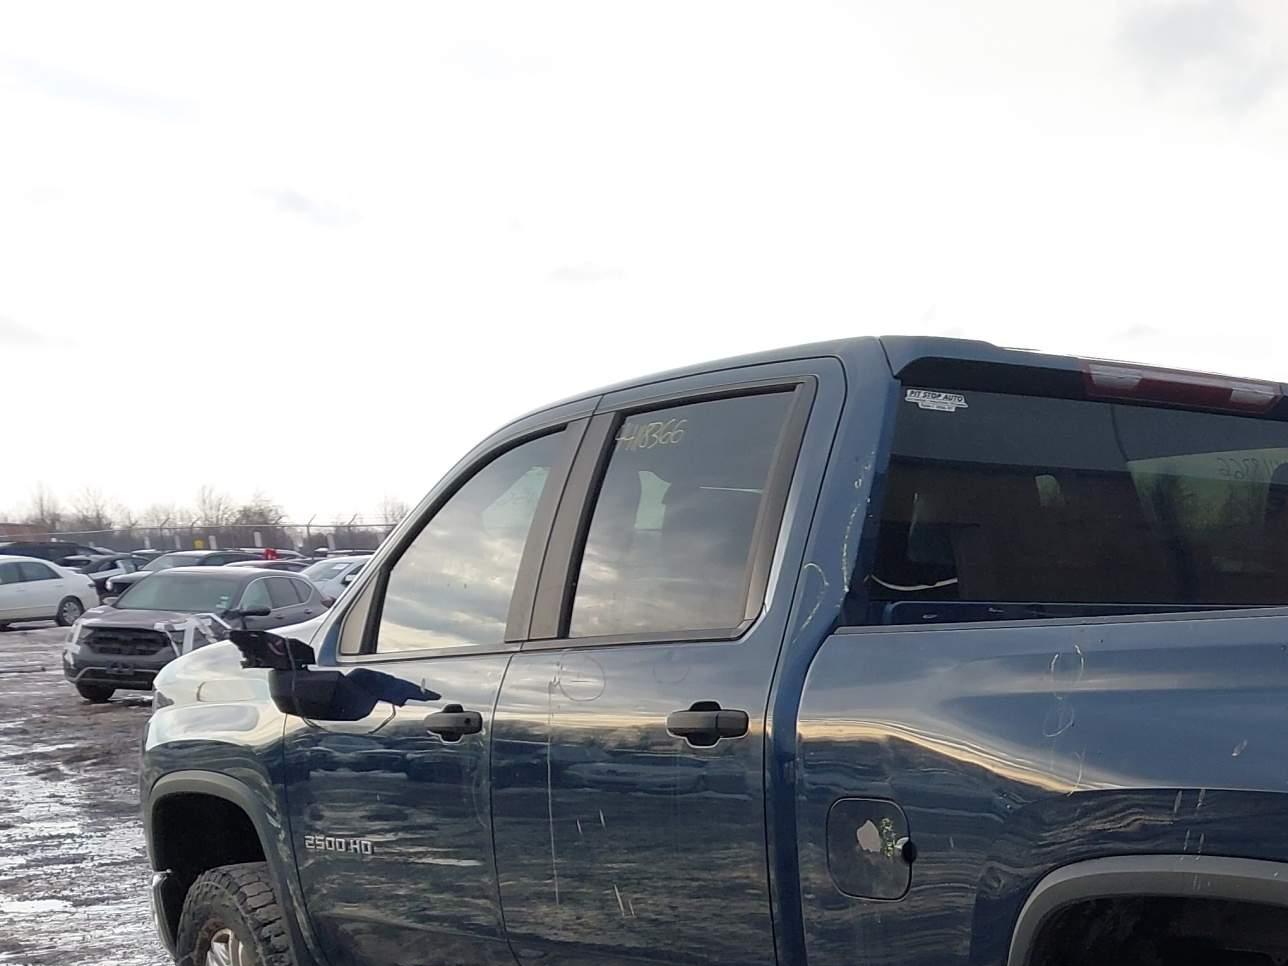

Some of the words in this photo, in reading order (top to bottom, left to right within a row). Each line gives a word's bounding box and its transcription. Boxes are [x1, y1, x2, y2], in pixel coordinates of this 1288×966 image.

[910, 389, 921, 397] PIT
[922, 391, 942, 399] STOP
[943, 394, 963, 402] AUTO
[303, 834, 345, 851] 2500
[349, 839, 373, 855] HD
